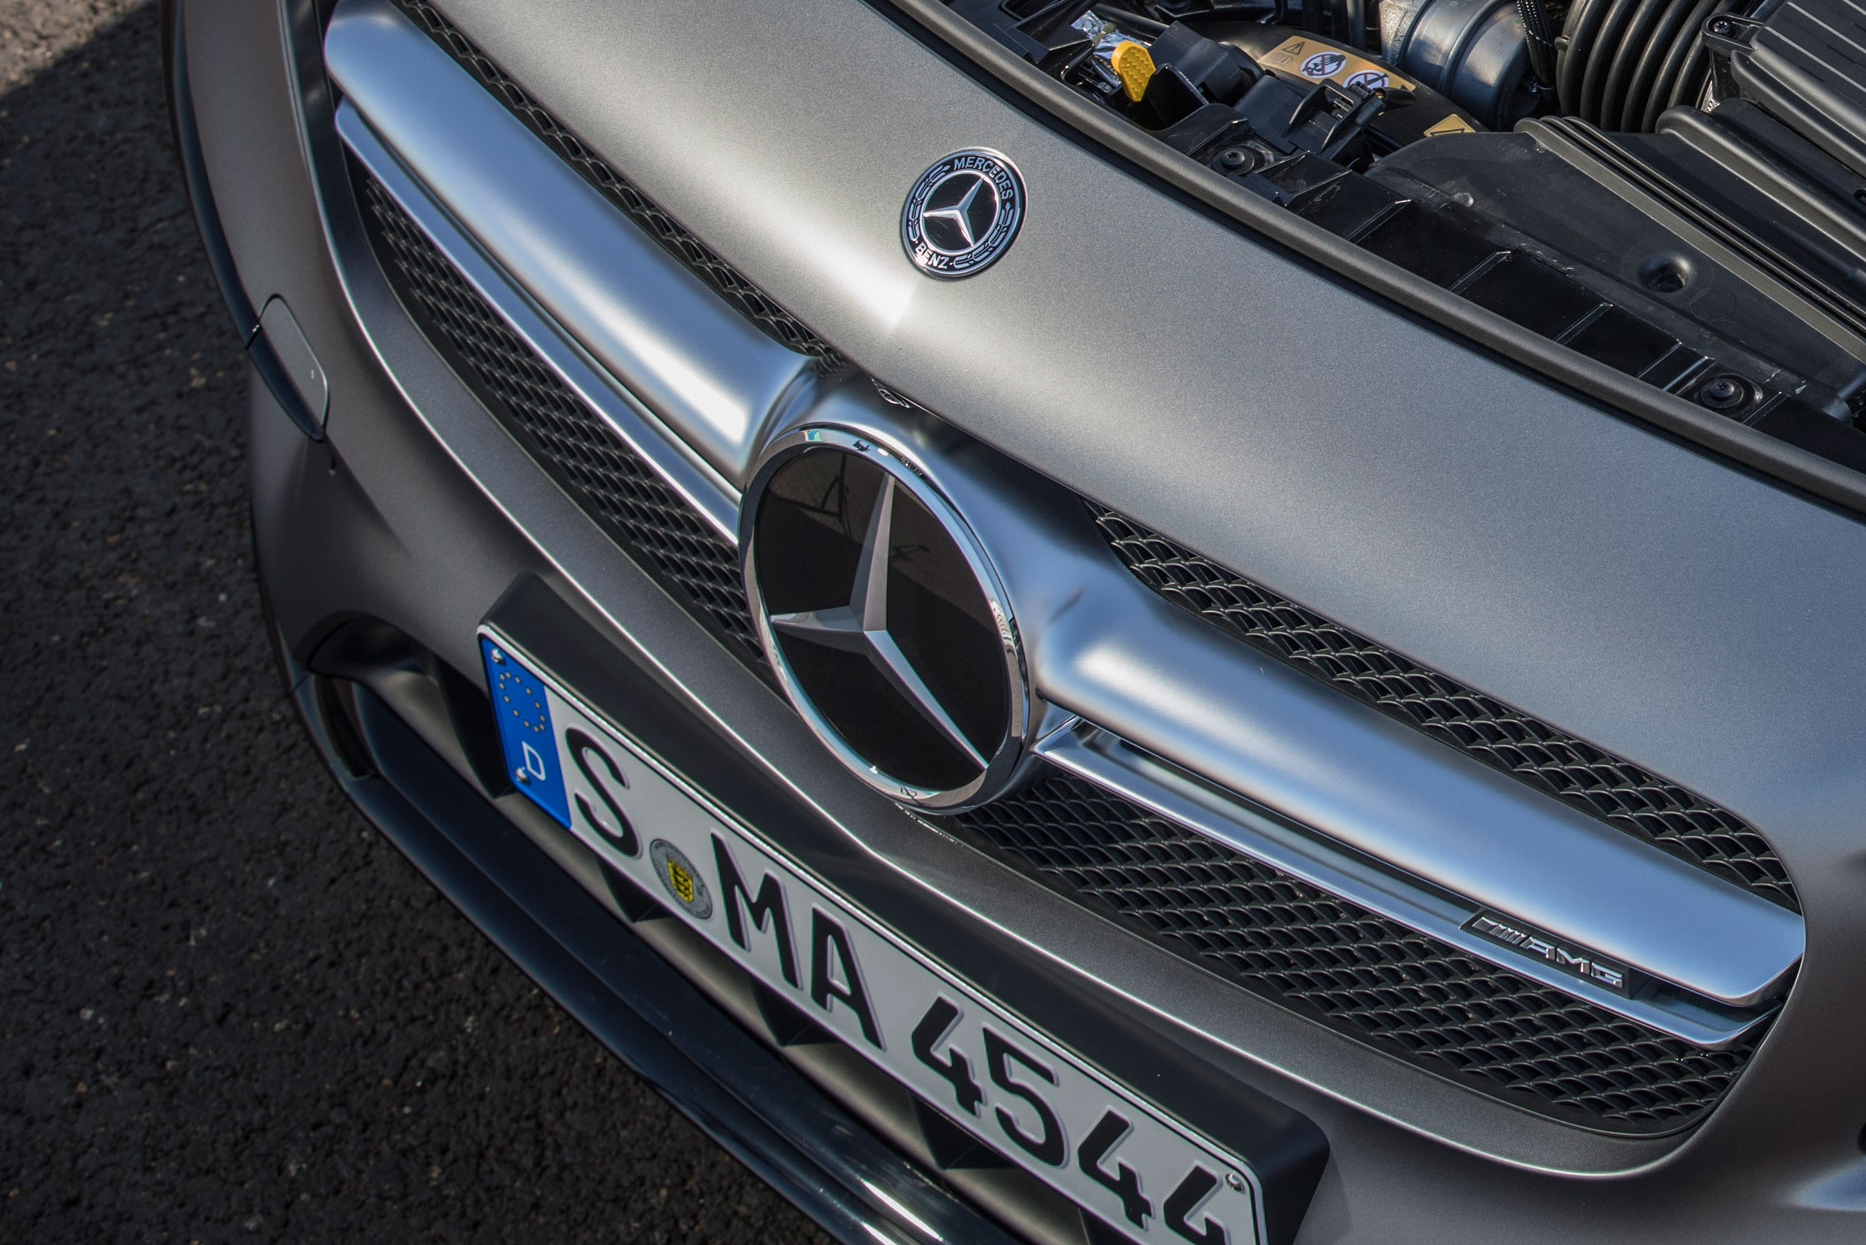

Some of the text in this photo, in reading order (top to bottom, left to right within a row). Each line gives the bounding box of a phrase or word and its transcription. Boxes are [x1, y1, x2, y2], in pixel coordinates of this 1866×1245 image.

[915, 156, 1014, 269] MERCEDES BENZ
[522, 722, 546, 781] D
[565, 726, 1230, 1245] S MA 4544
[1519, 936, 1623, 988] AMG
